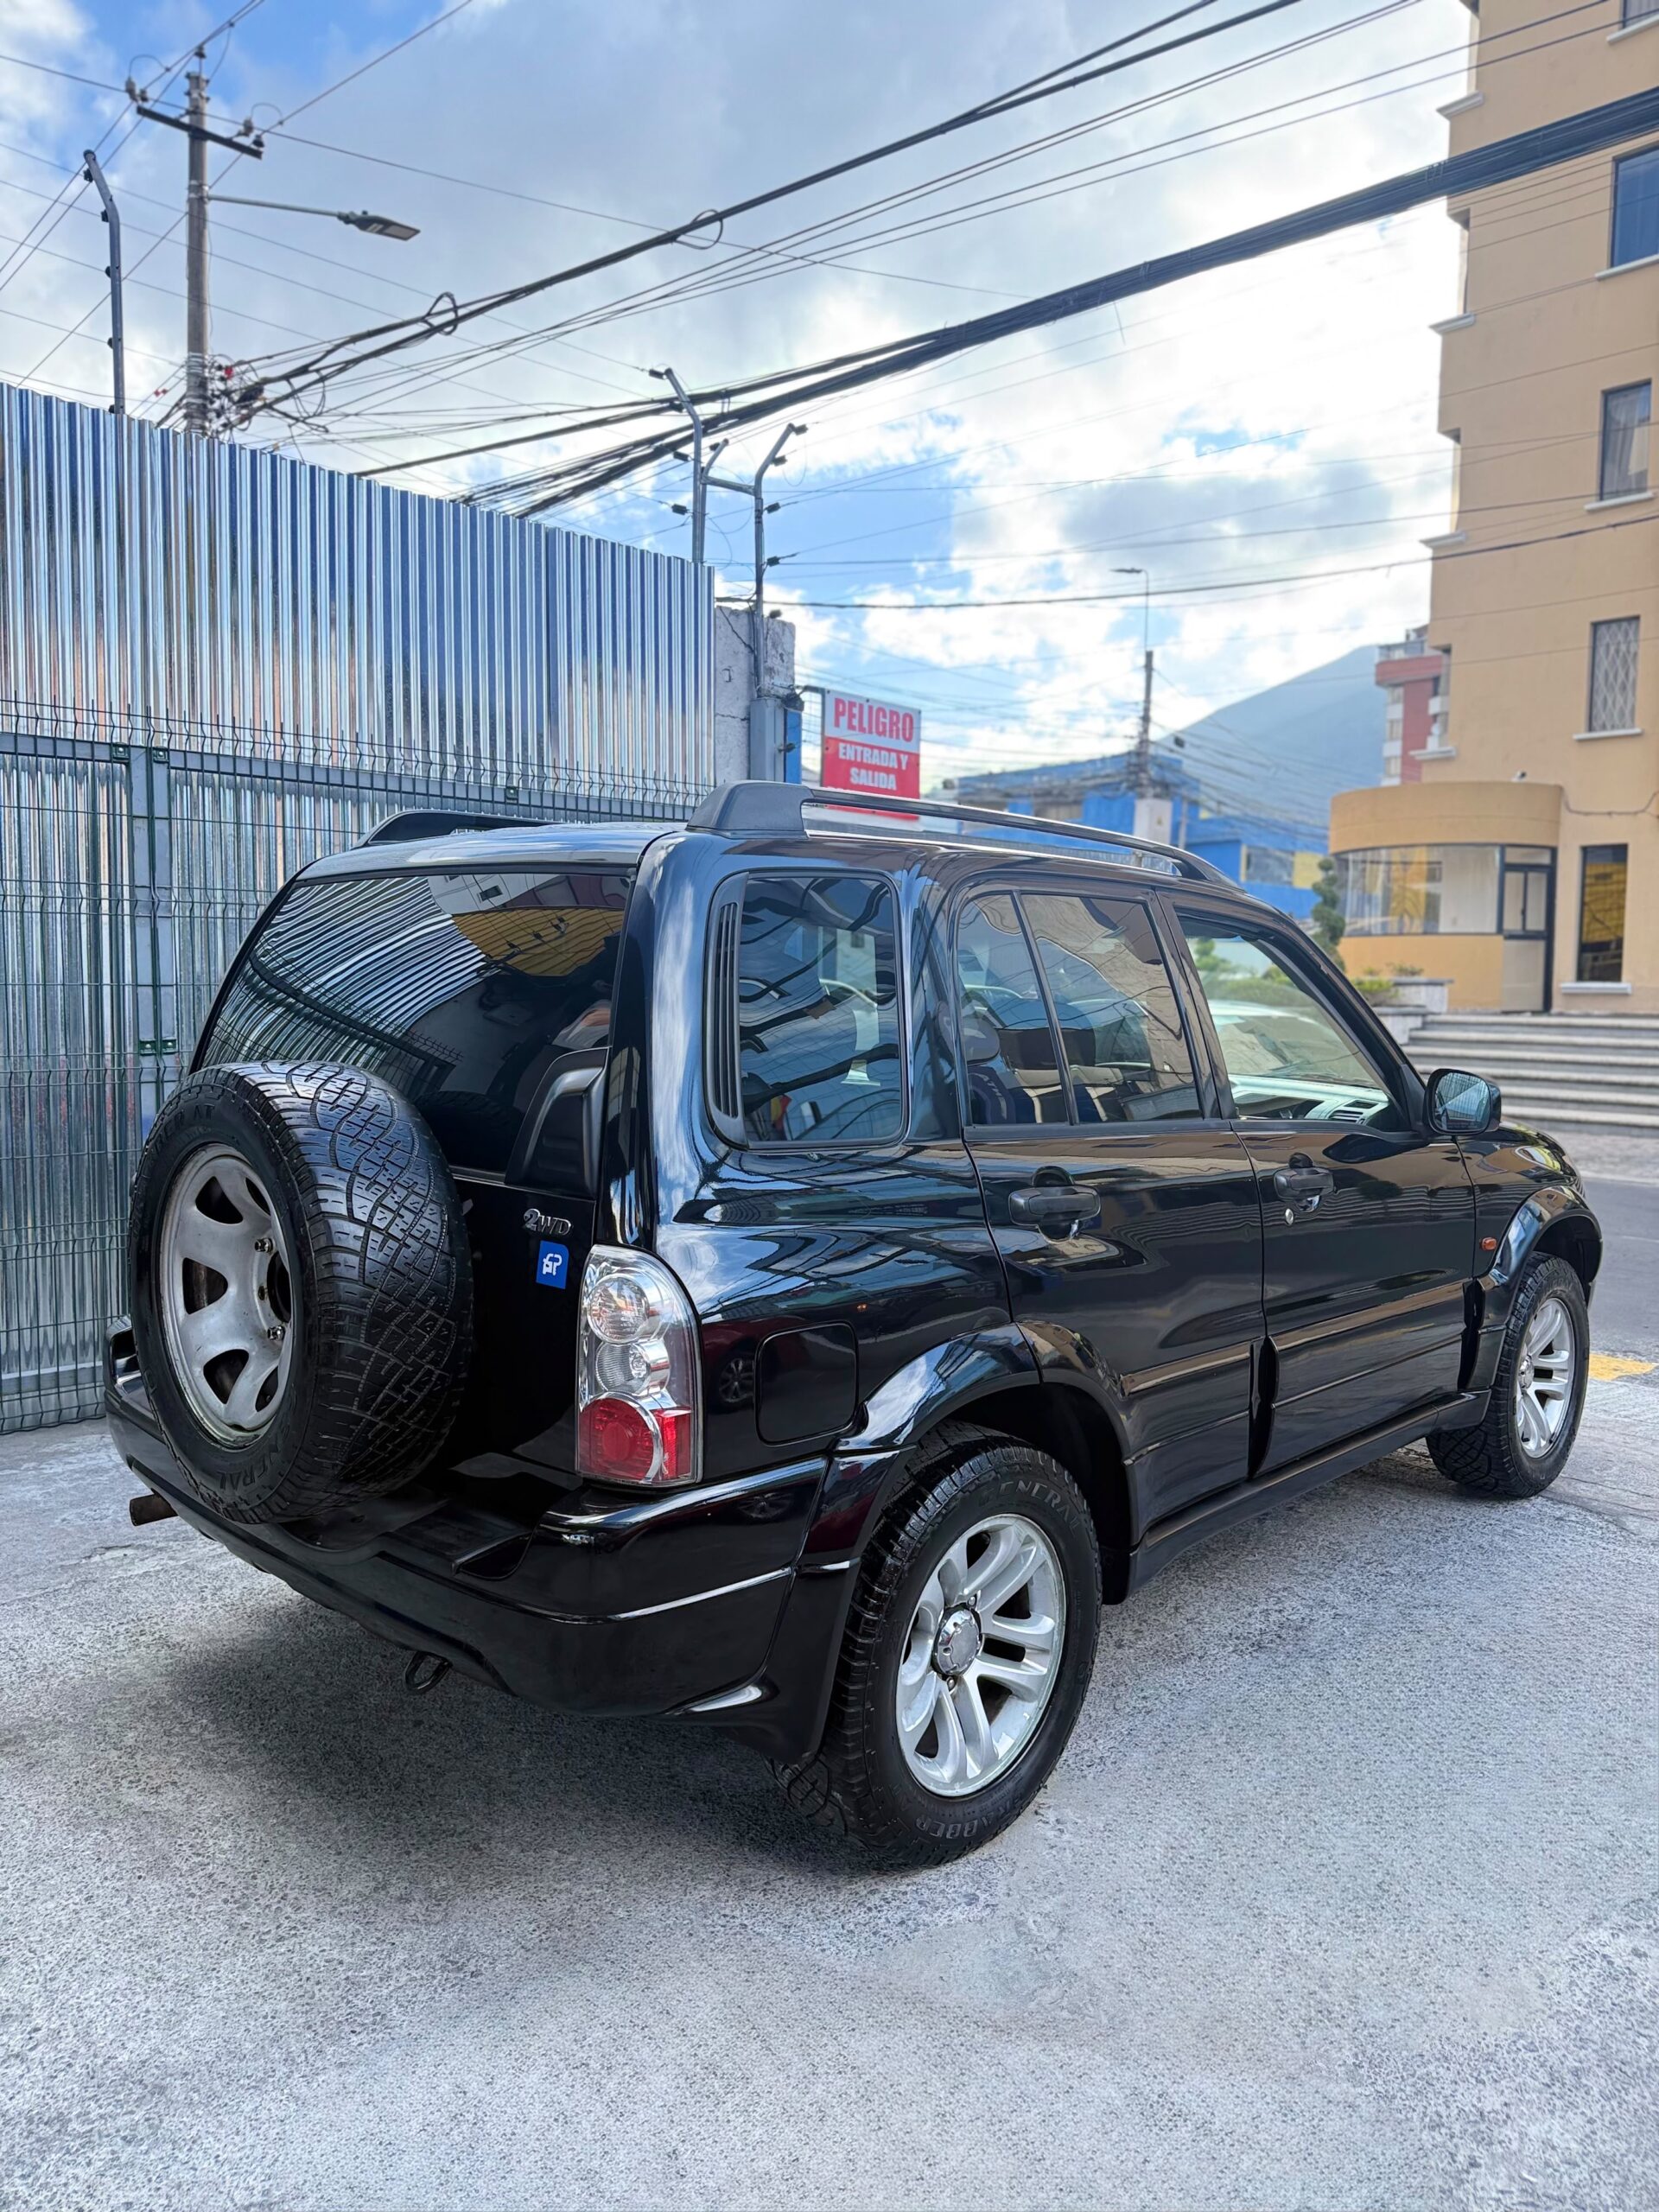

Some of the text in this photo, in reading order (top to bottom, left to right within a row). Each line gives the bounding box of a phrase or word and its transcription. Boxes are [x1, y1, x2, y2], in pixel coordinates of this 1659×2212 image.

[834, 697, 913, 742] PELIGRO
[838, 742, 909, 770] ENTRADA Y
[850, 766, 897, 791] SALIDA
[523, 1208, 572, 1236] 2WD
